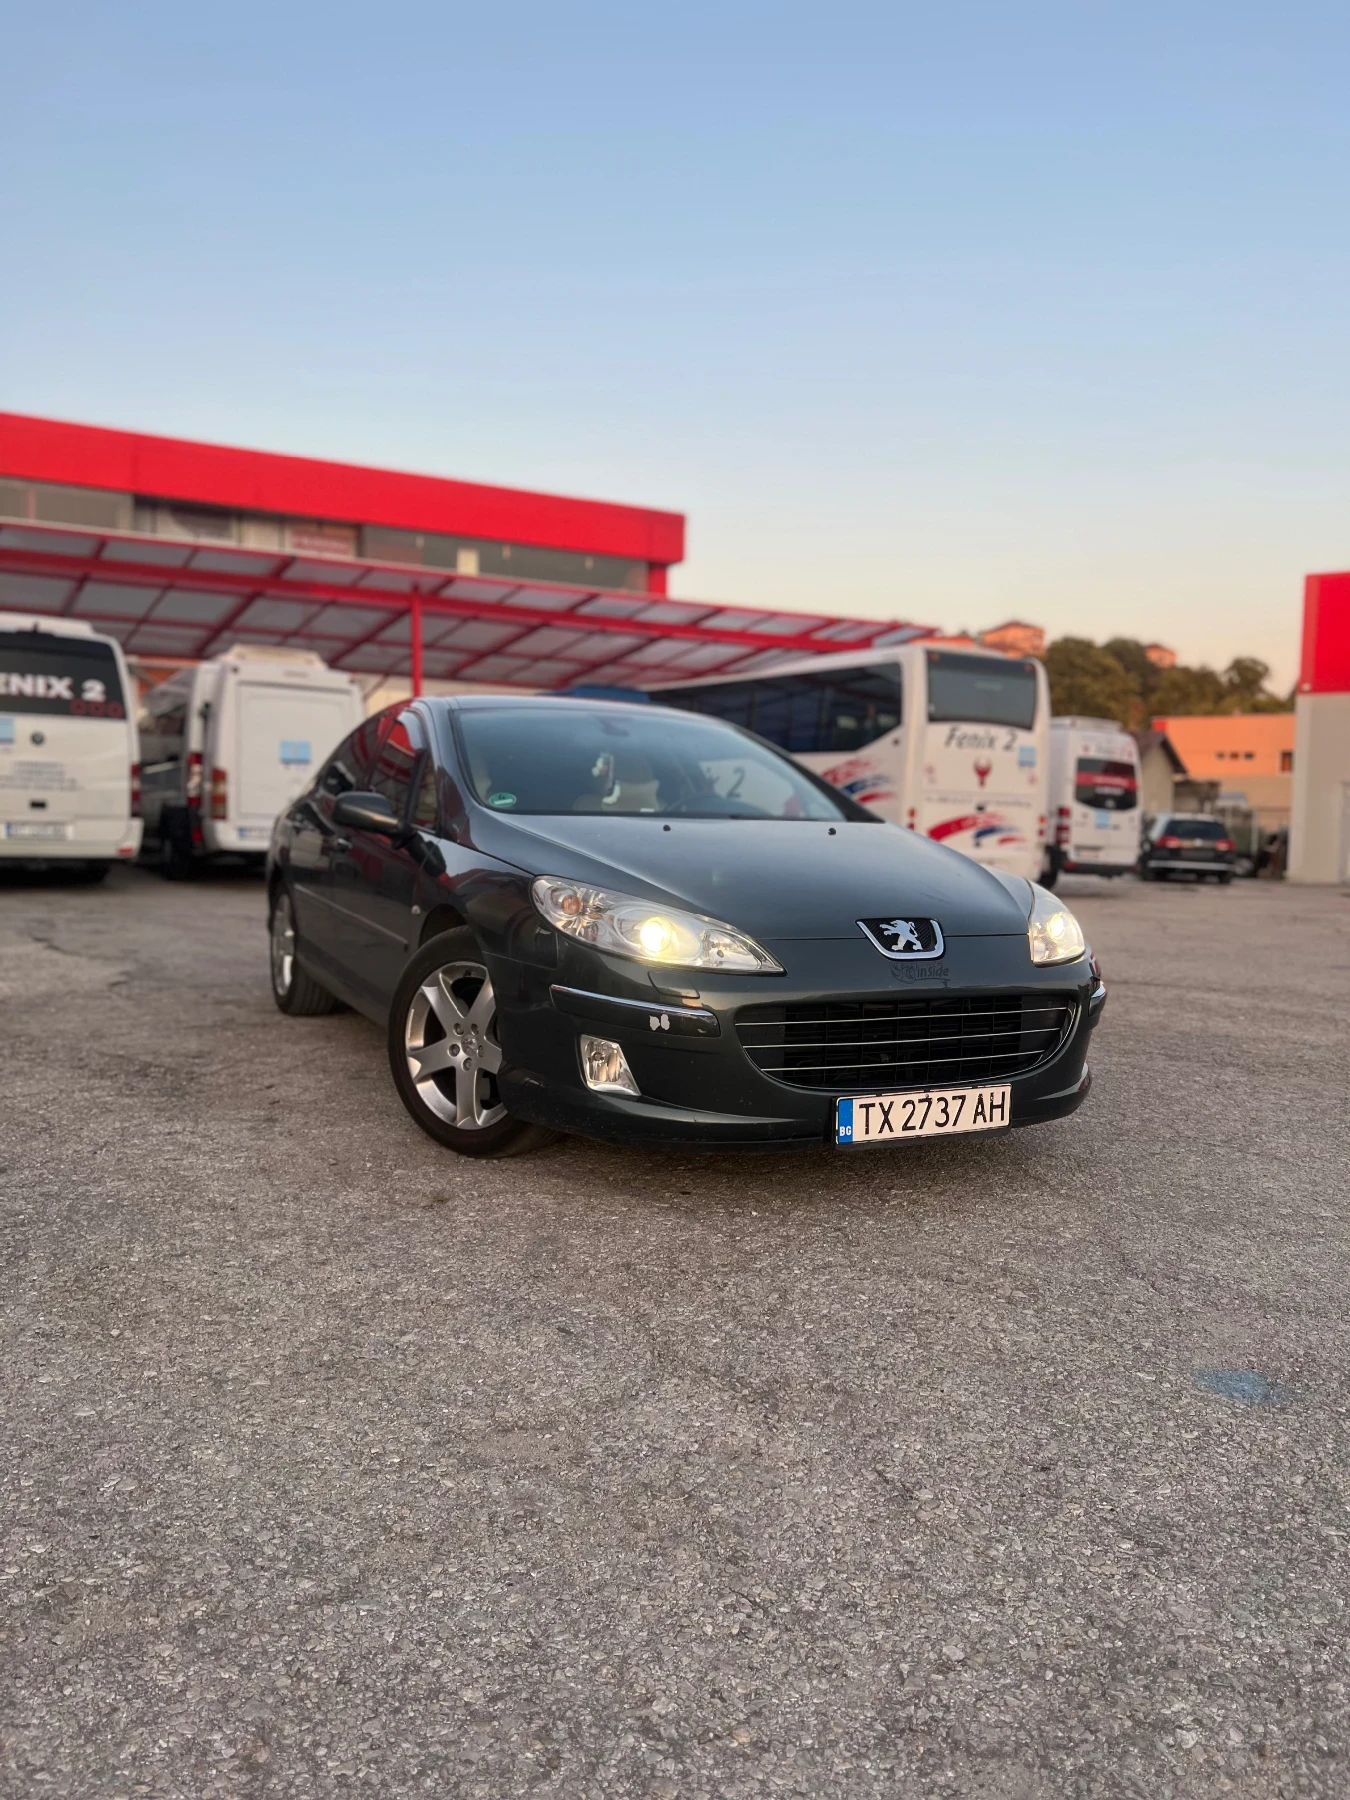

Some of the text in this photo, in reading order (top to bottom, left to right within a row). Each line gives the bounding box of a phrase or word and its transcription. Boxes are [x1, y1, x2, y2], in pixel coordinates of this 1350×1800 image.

[81, 679, 106, 702] 2
[944, 725, 1017, 751] Fenix 2
[859, 1091, 1005, 1135] TX 2737 AH
[839, 1125, 852, 1136] BG
